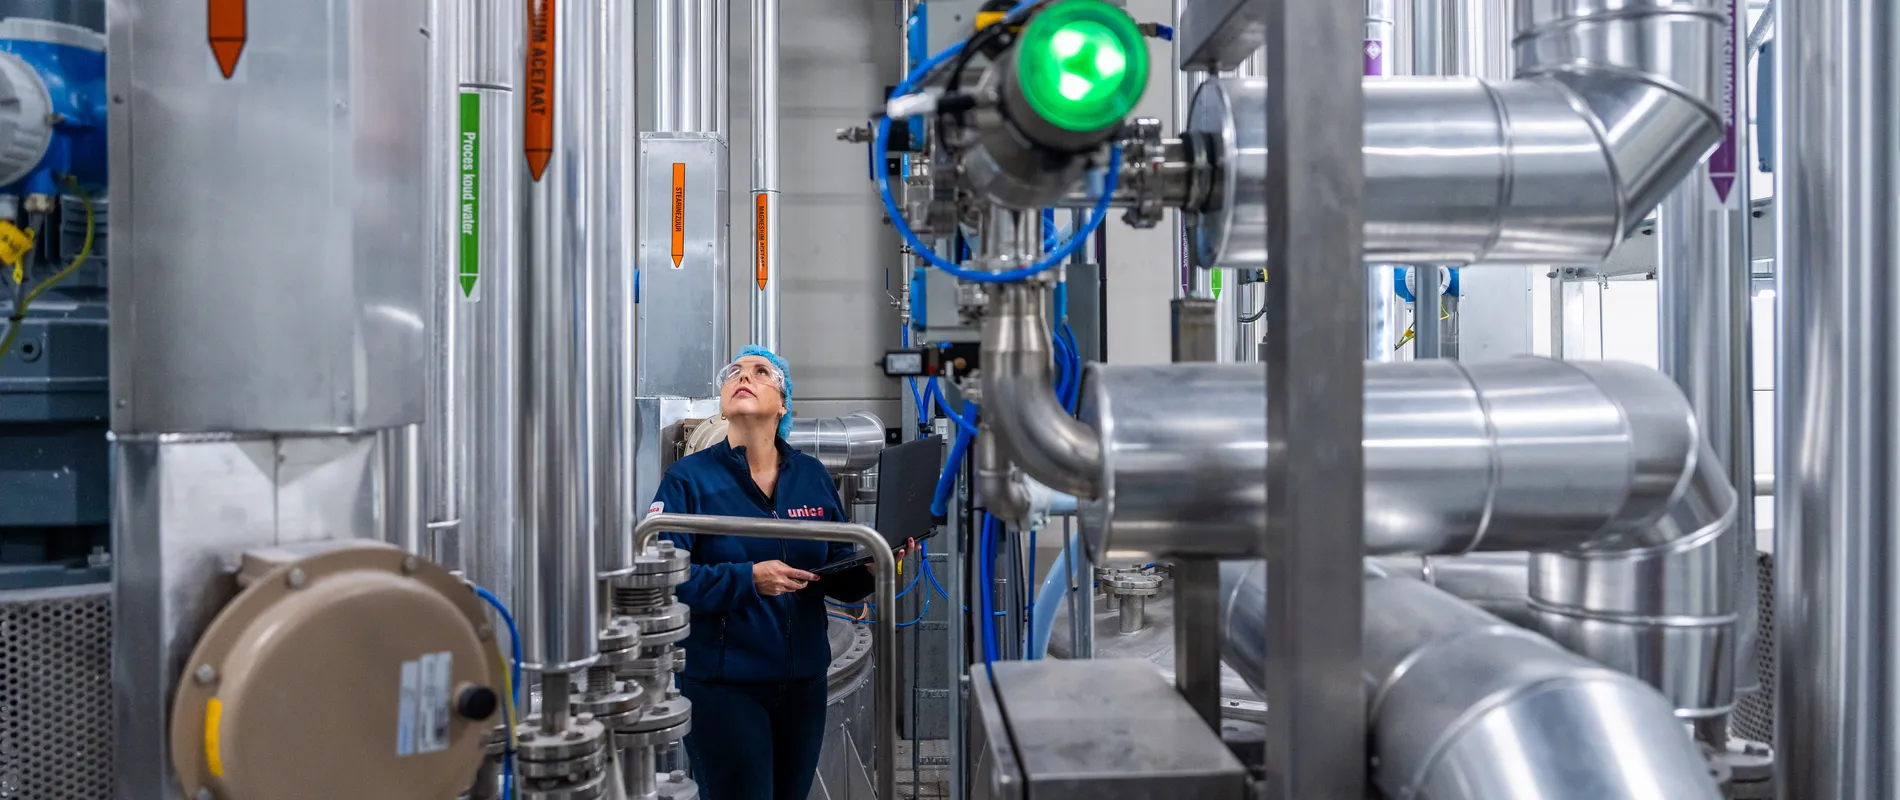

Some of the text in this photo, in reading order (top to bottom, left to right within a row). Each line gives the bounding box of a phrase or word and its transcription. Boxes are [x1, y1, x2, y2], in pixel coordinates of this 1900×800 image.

[531, 47, 547, 116] ACETAAT
[462, 132, 476, 235] Proces koud water
[787, 504, 824, 518] unica
